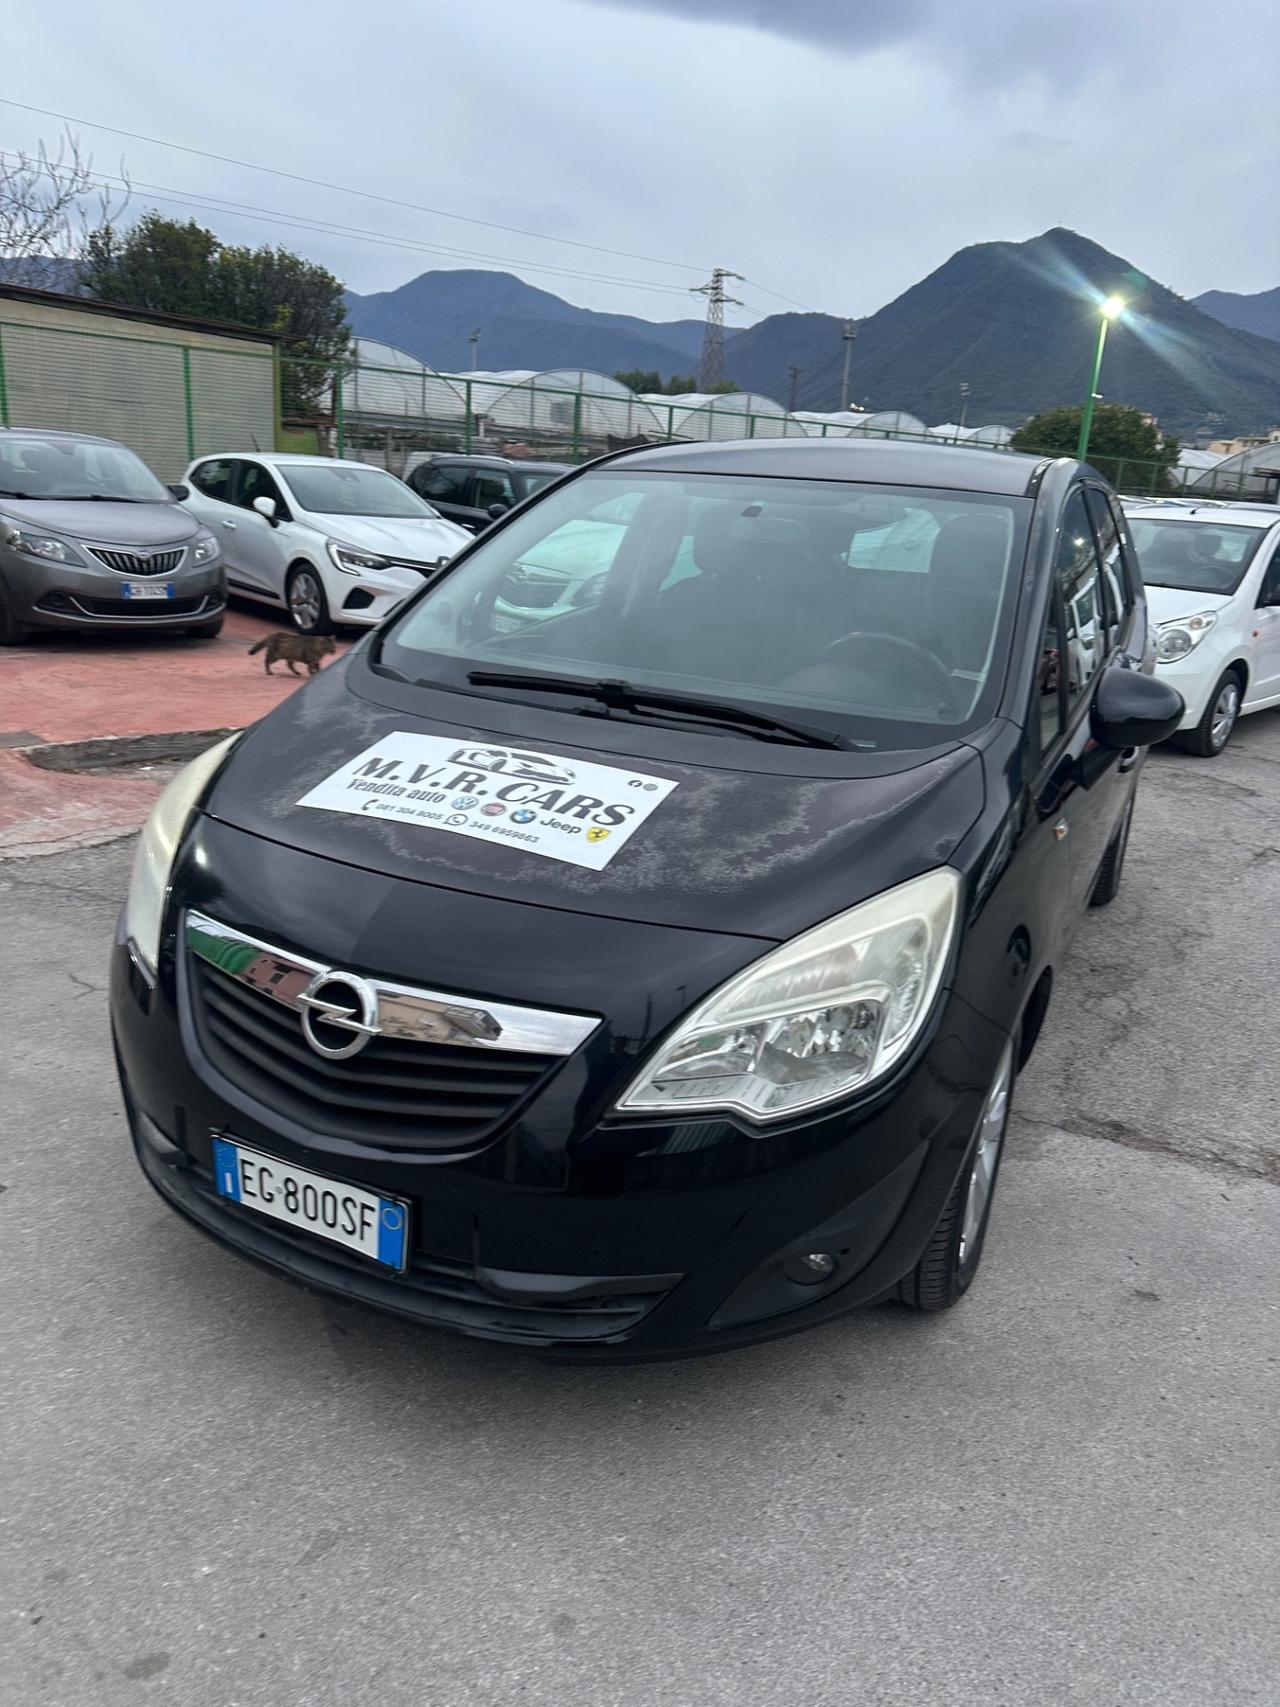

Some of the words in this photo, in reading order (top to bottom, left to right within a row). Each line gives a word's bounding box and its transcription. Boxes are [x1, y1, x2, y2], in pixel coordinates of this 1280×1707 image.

[346, 779, 407, 797] Vendita
[406, 789, 446, 803] auto
[352, 757, 488, 796] M.V.R.
[496, 783, 635, 826] CARS
[540, 818, 582, 834] Jeep
